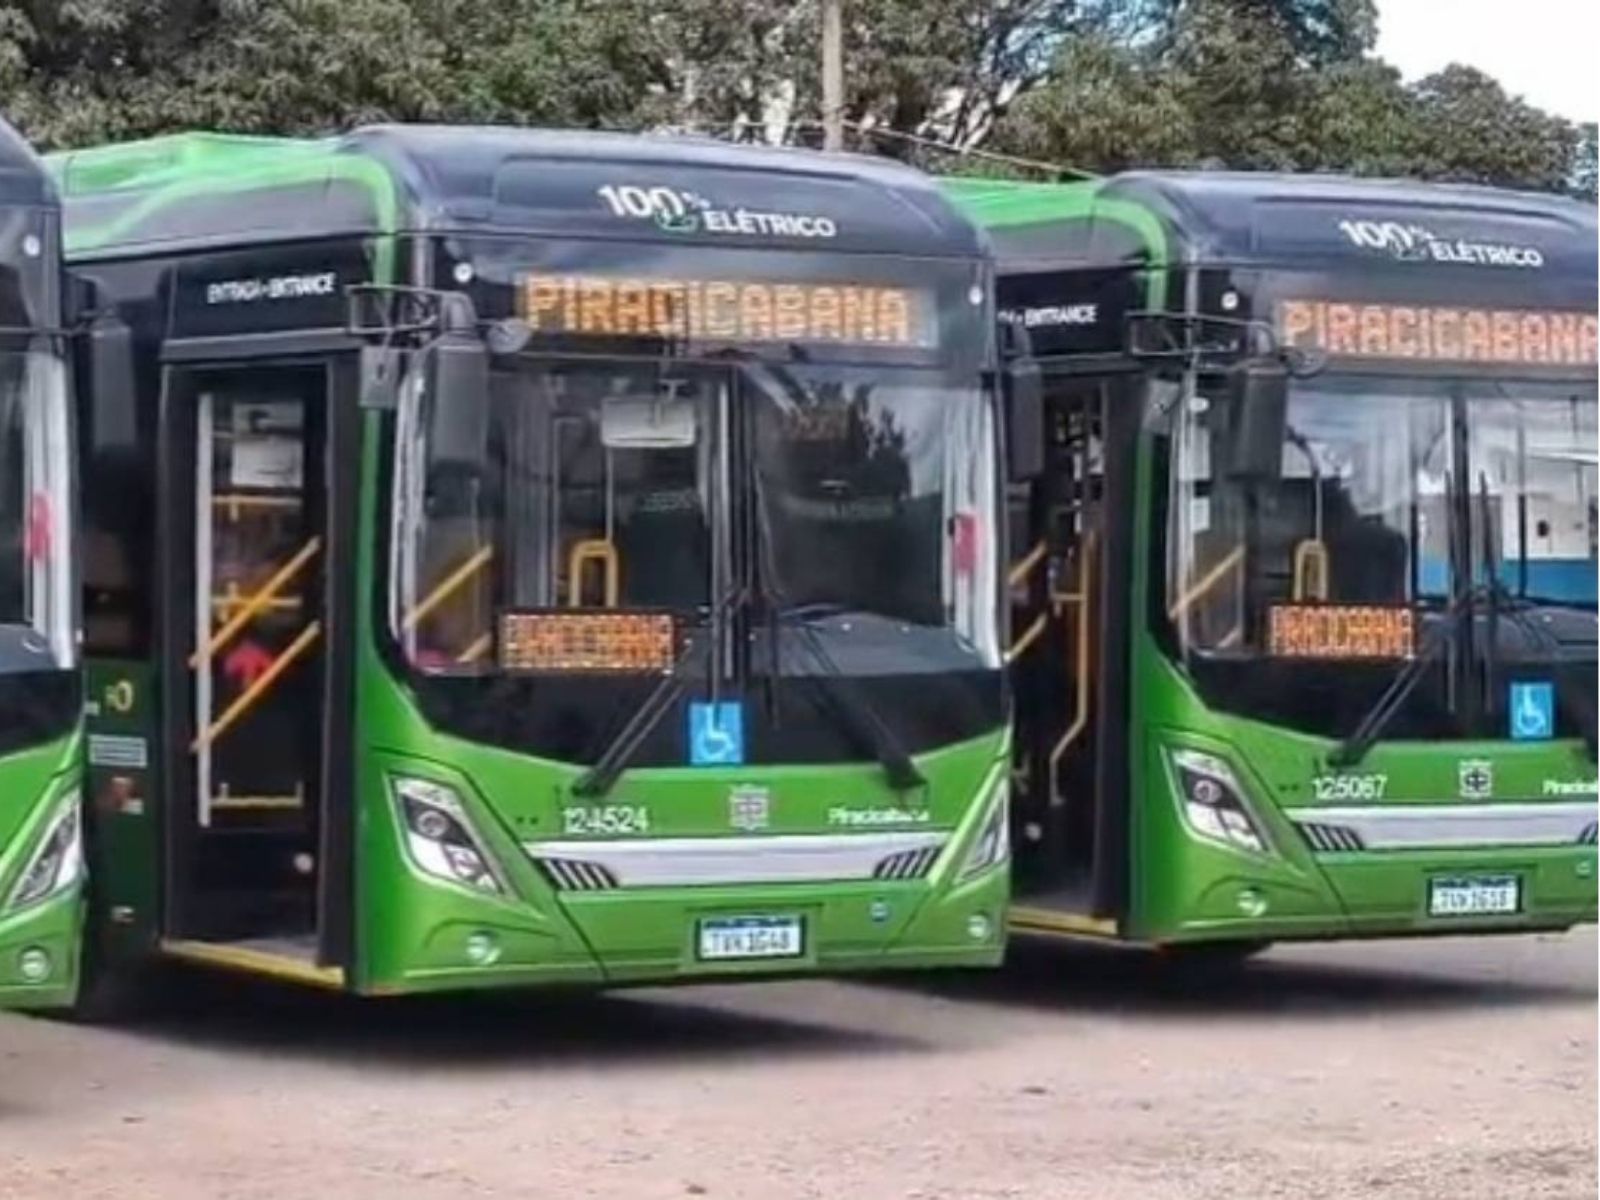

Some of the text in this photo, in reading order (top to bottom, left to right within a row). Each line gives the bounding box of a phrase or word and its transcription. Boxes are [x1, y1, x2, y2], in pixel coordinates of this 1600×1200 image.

[702, 208, 837, 238] ELÉTRICO
[1428, 239, 1544, 267] ELÉTRICO
[526, 274, 910, 343] PIRACICABANA
[1282, 300, 1598, 364] PIRACICABANA
[1311, 774, 1388, 799] 125067
[562, 806, 649, 834] 124524
